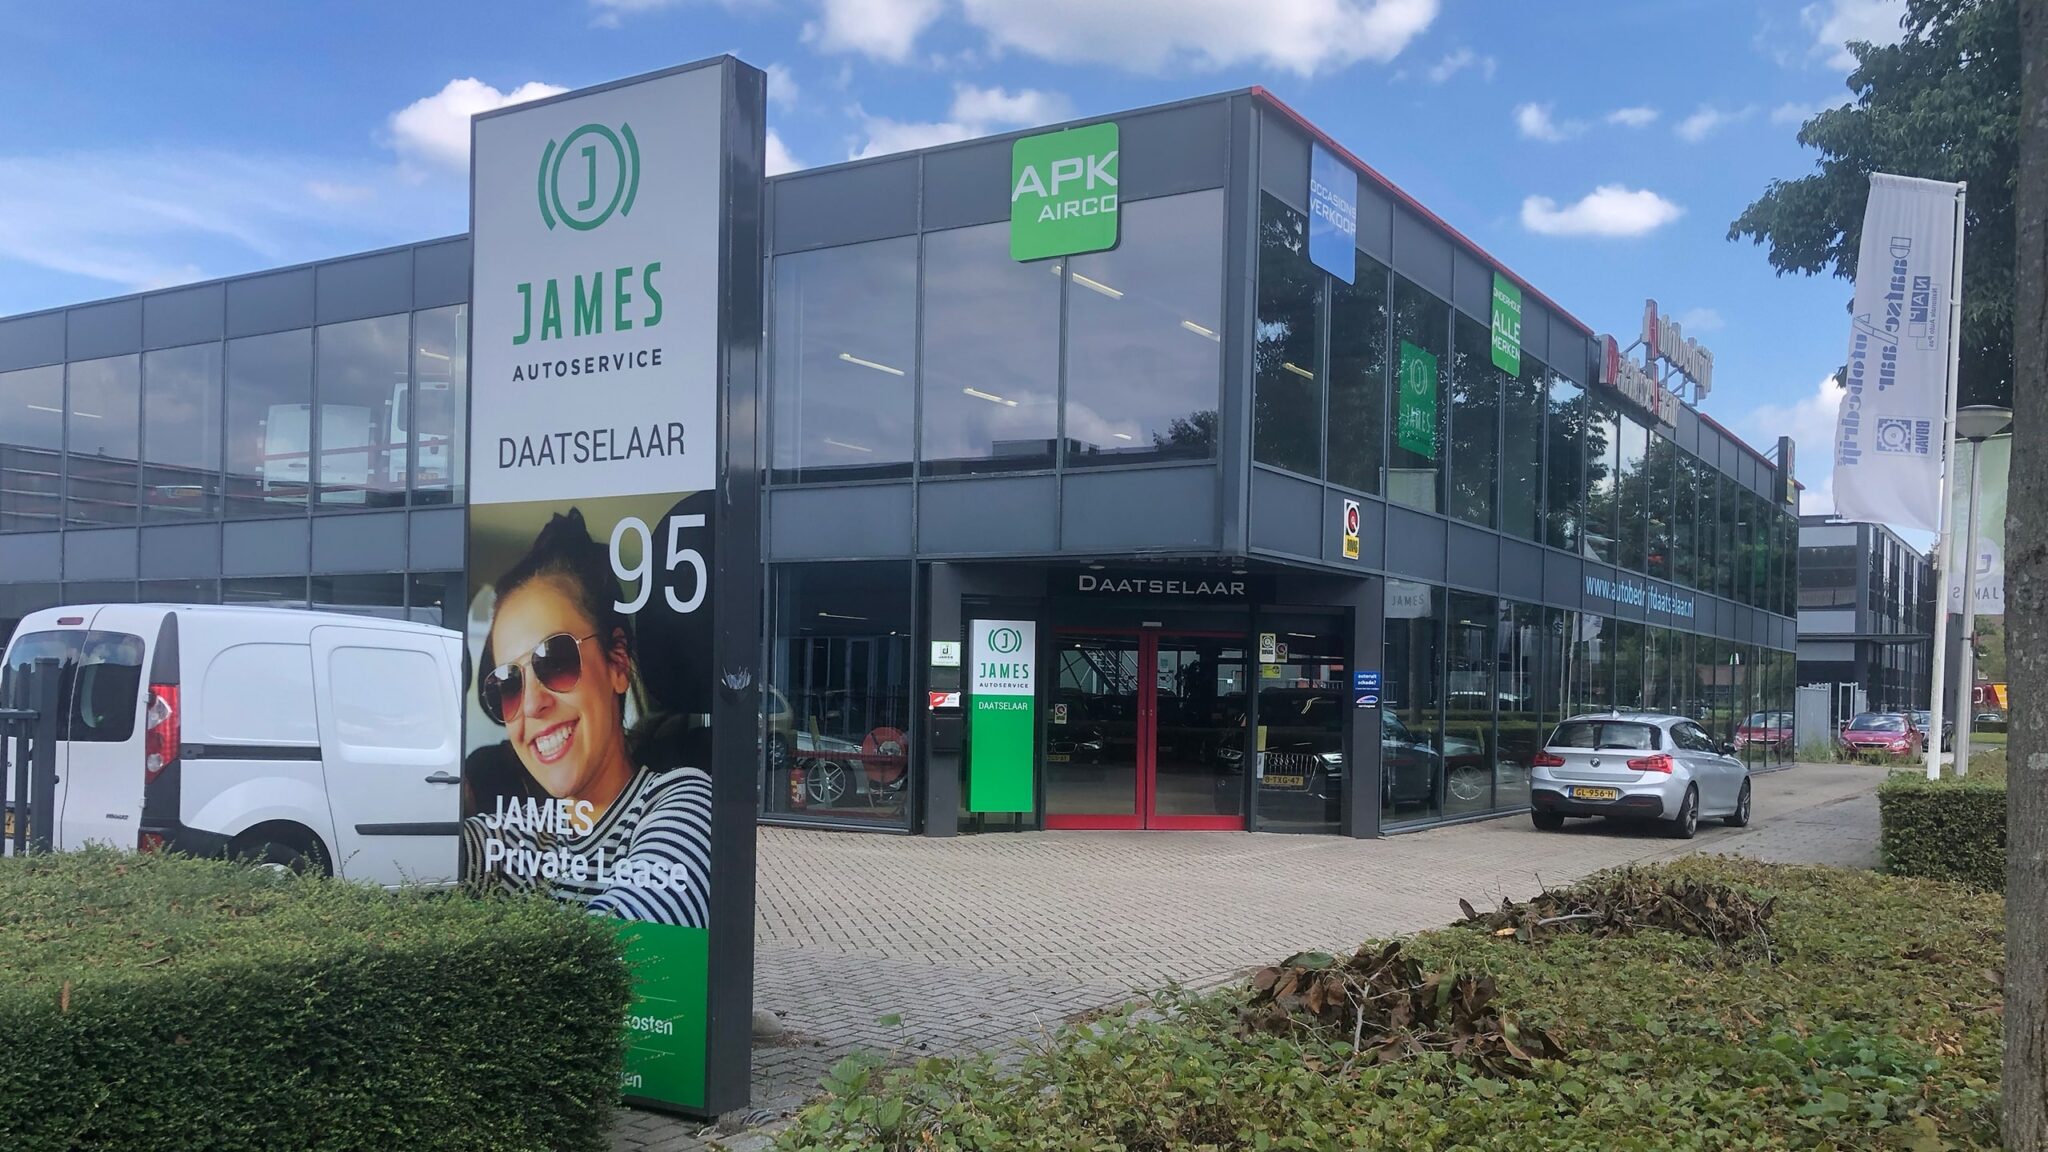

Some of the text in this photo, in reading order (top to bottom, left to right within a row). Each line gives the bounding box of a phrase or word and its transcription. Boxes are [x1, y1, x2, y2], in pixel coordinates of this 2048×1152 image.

[1011, 150, 1118, 202] APK
[1037, 194, 1118, 223] AIRCO
[1310, 180, 1357, 218] OCCASIONS
[1310, 197, 1357, 235] VERKOOP
[512, 261, 664, 346] JAMES
[1493, 309, 1521, 344] ALLE
[512, 348, 663, 382] AUTOSERVICE
[1492, 334, 1521, 361] MERKEN
[499, 422, 685, 469] DAATSELAAR
[609, 513, 708, 615] 95
[1585, 575, 1694, 618] www.autobedrjfdaatselaar.nl
[979, 663, 1029, 679] JAMES
[978, 701, 1028, 710] DAATSELAAR
[1576, 789, 1613, 797] GL-956-H
[485, 795, 595, 837] JAMES
[485, 838, 689, 892] Private Lease
